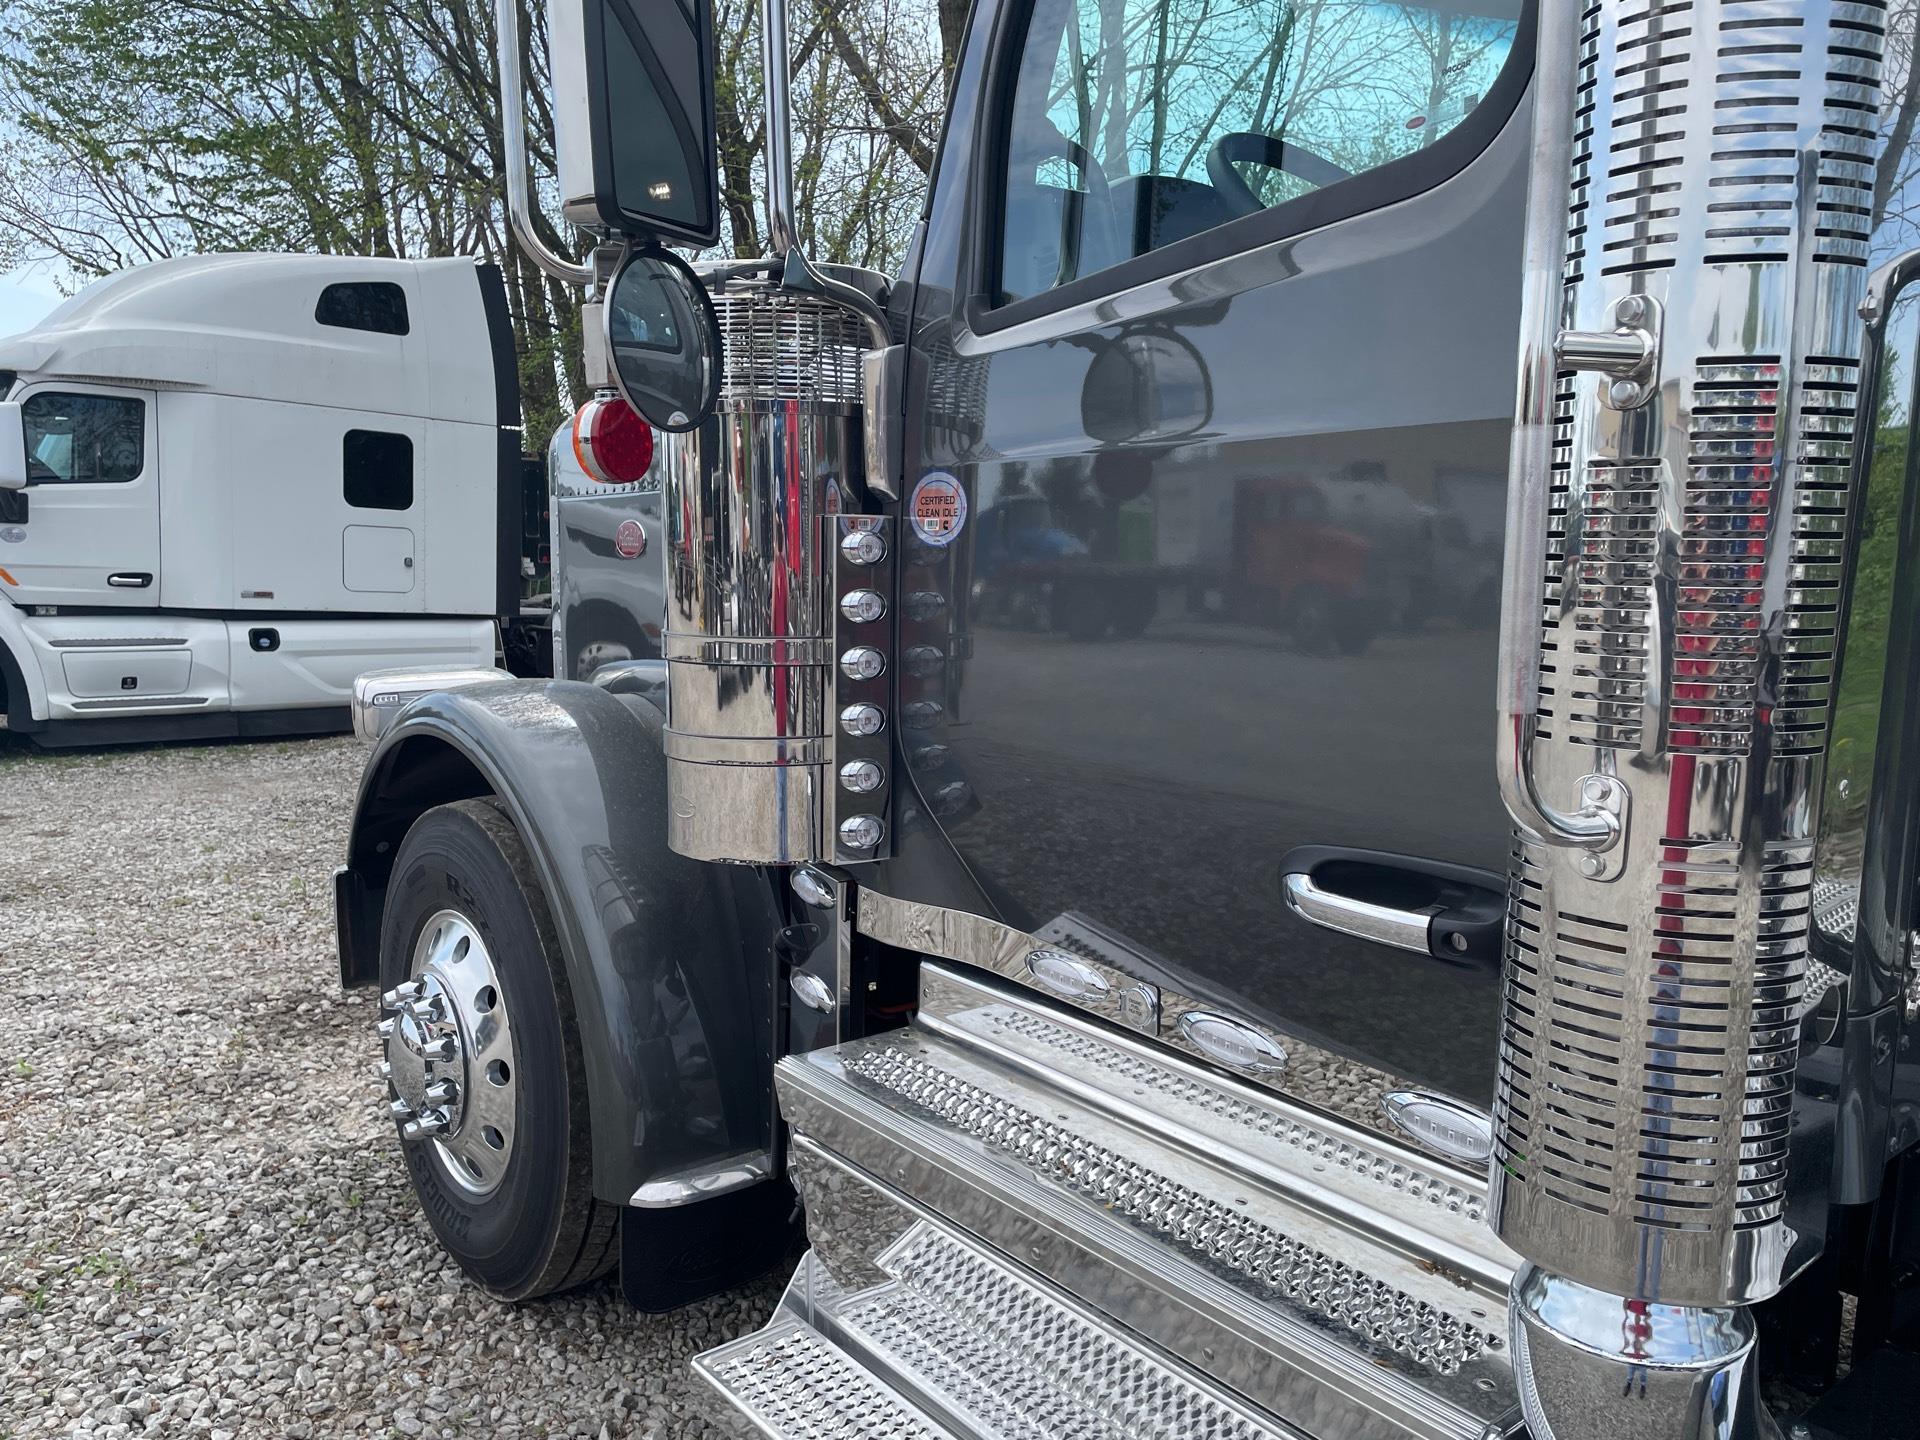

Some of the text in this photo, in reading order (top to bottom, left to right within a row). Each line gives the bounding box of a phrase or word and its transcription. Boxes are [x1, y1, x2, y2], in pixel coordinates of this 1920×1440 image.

[920, 495, 956, 506] CERTIFIED
[917, 508, 959, 518] CLEAN IDLE
